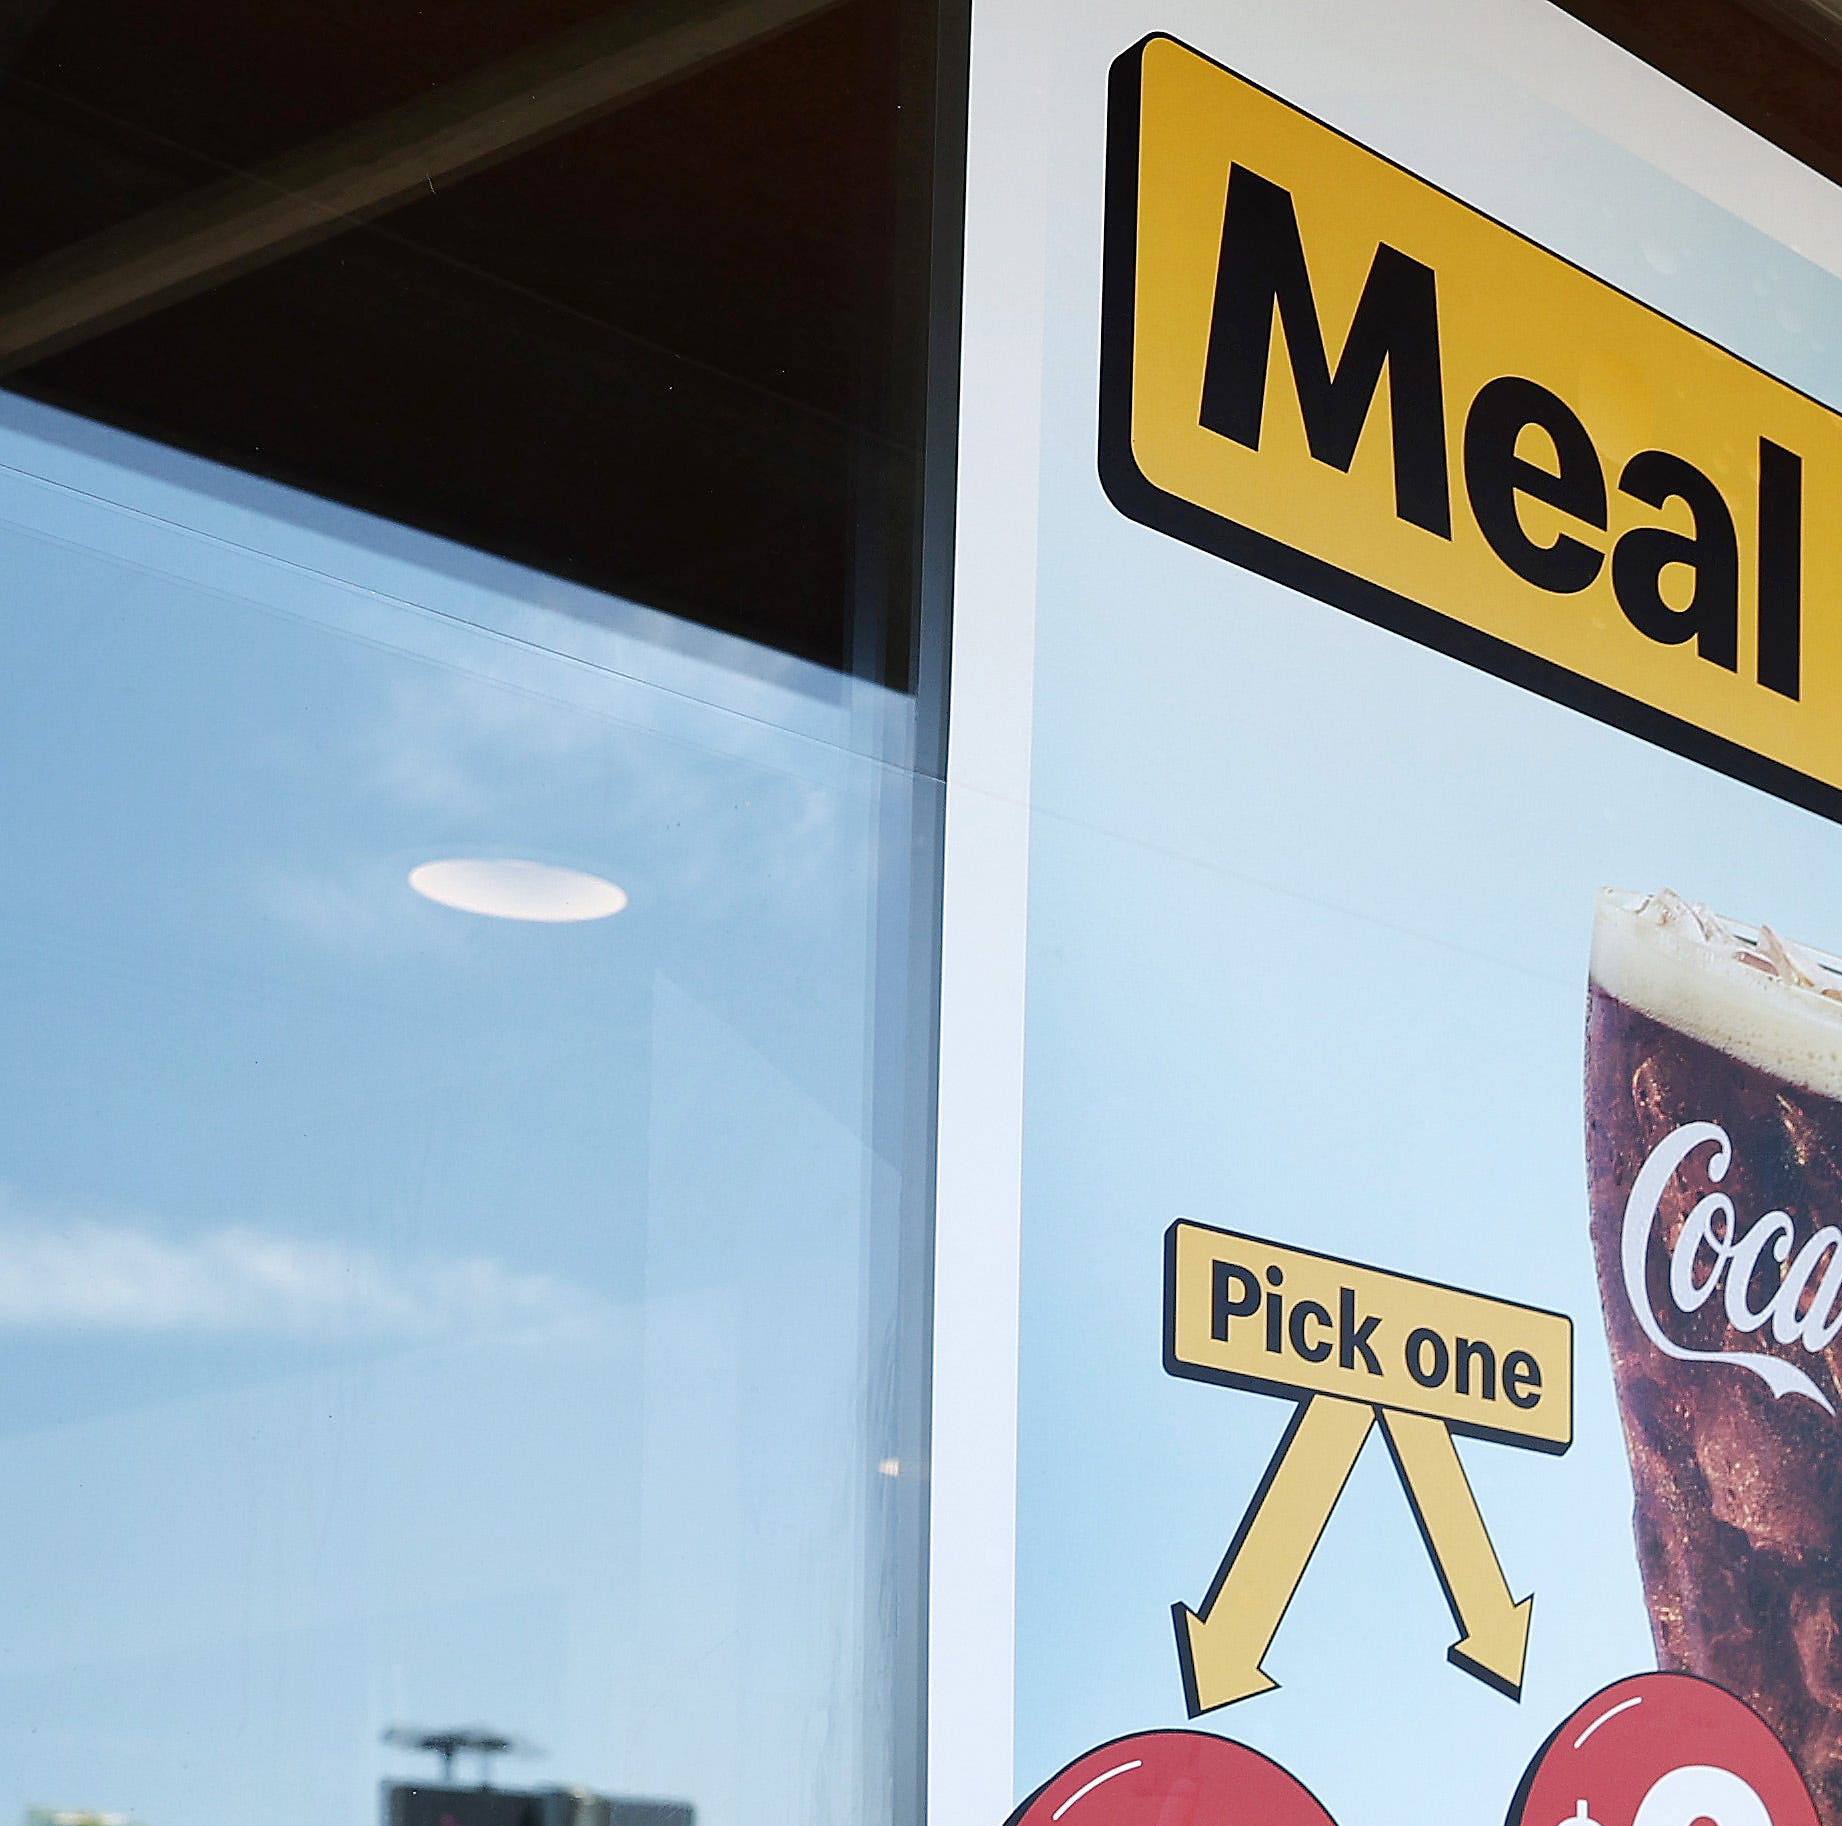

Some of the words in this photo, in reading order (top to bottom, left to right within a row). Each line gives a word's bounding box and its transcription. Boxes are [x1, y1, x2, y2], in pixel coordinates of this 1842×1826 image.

[1197, 159, 1802, 703] Meal
[1210, 1258, 1385, 1378] Pick
[1404, 1326, 1543, 1410] one
